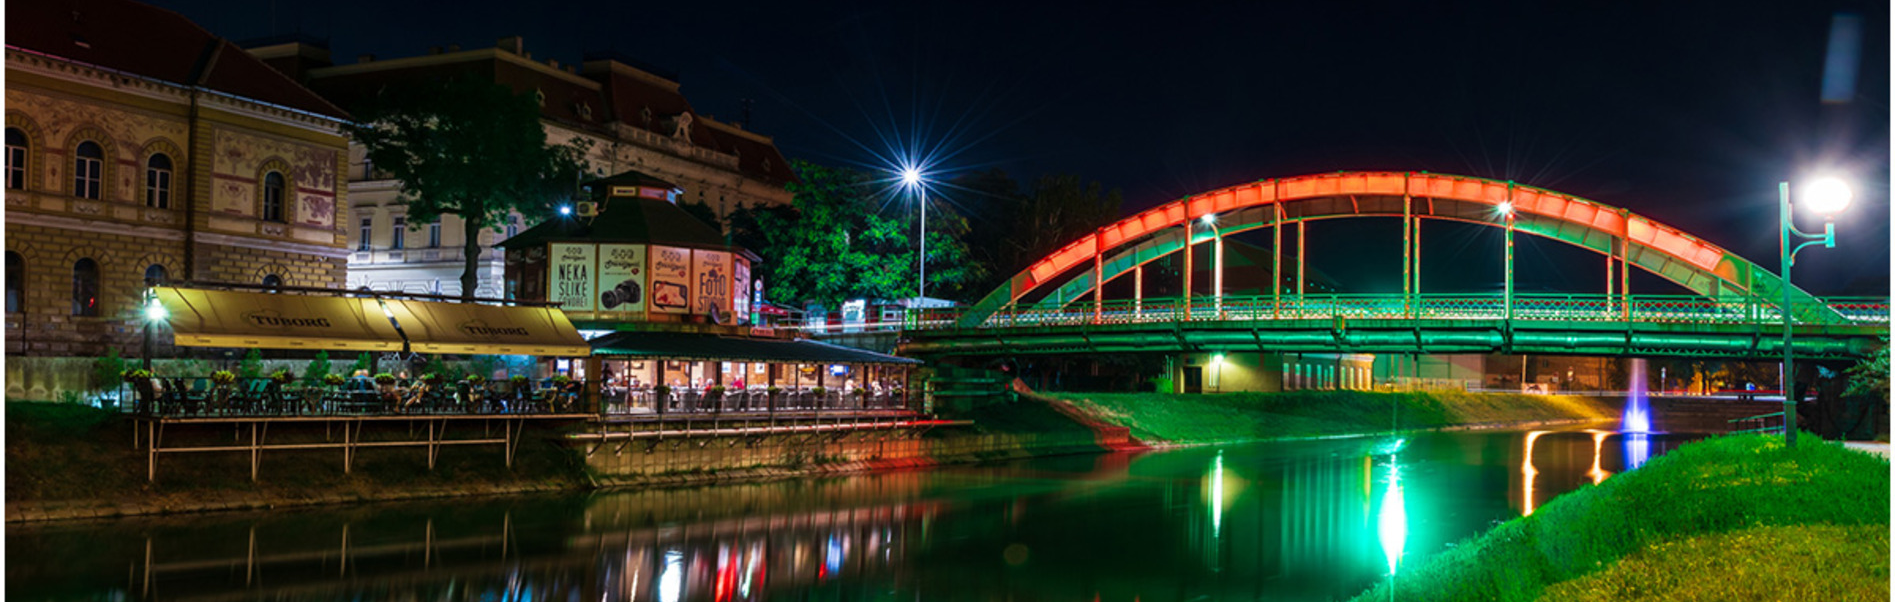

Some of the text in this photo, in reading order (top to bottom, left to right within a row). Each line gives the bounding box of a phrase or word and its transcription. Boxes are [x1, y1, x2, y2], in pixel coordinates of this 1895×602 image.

[559, 264, 587, 281] NEKA
[559, 281, 587, 297] SLIKE
[699, 272, 727, 296] FOTO
[251, 315, 330, 327] TUBORG
[465, 325, 529, 336] TUBORG
